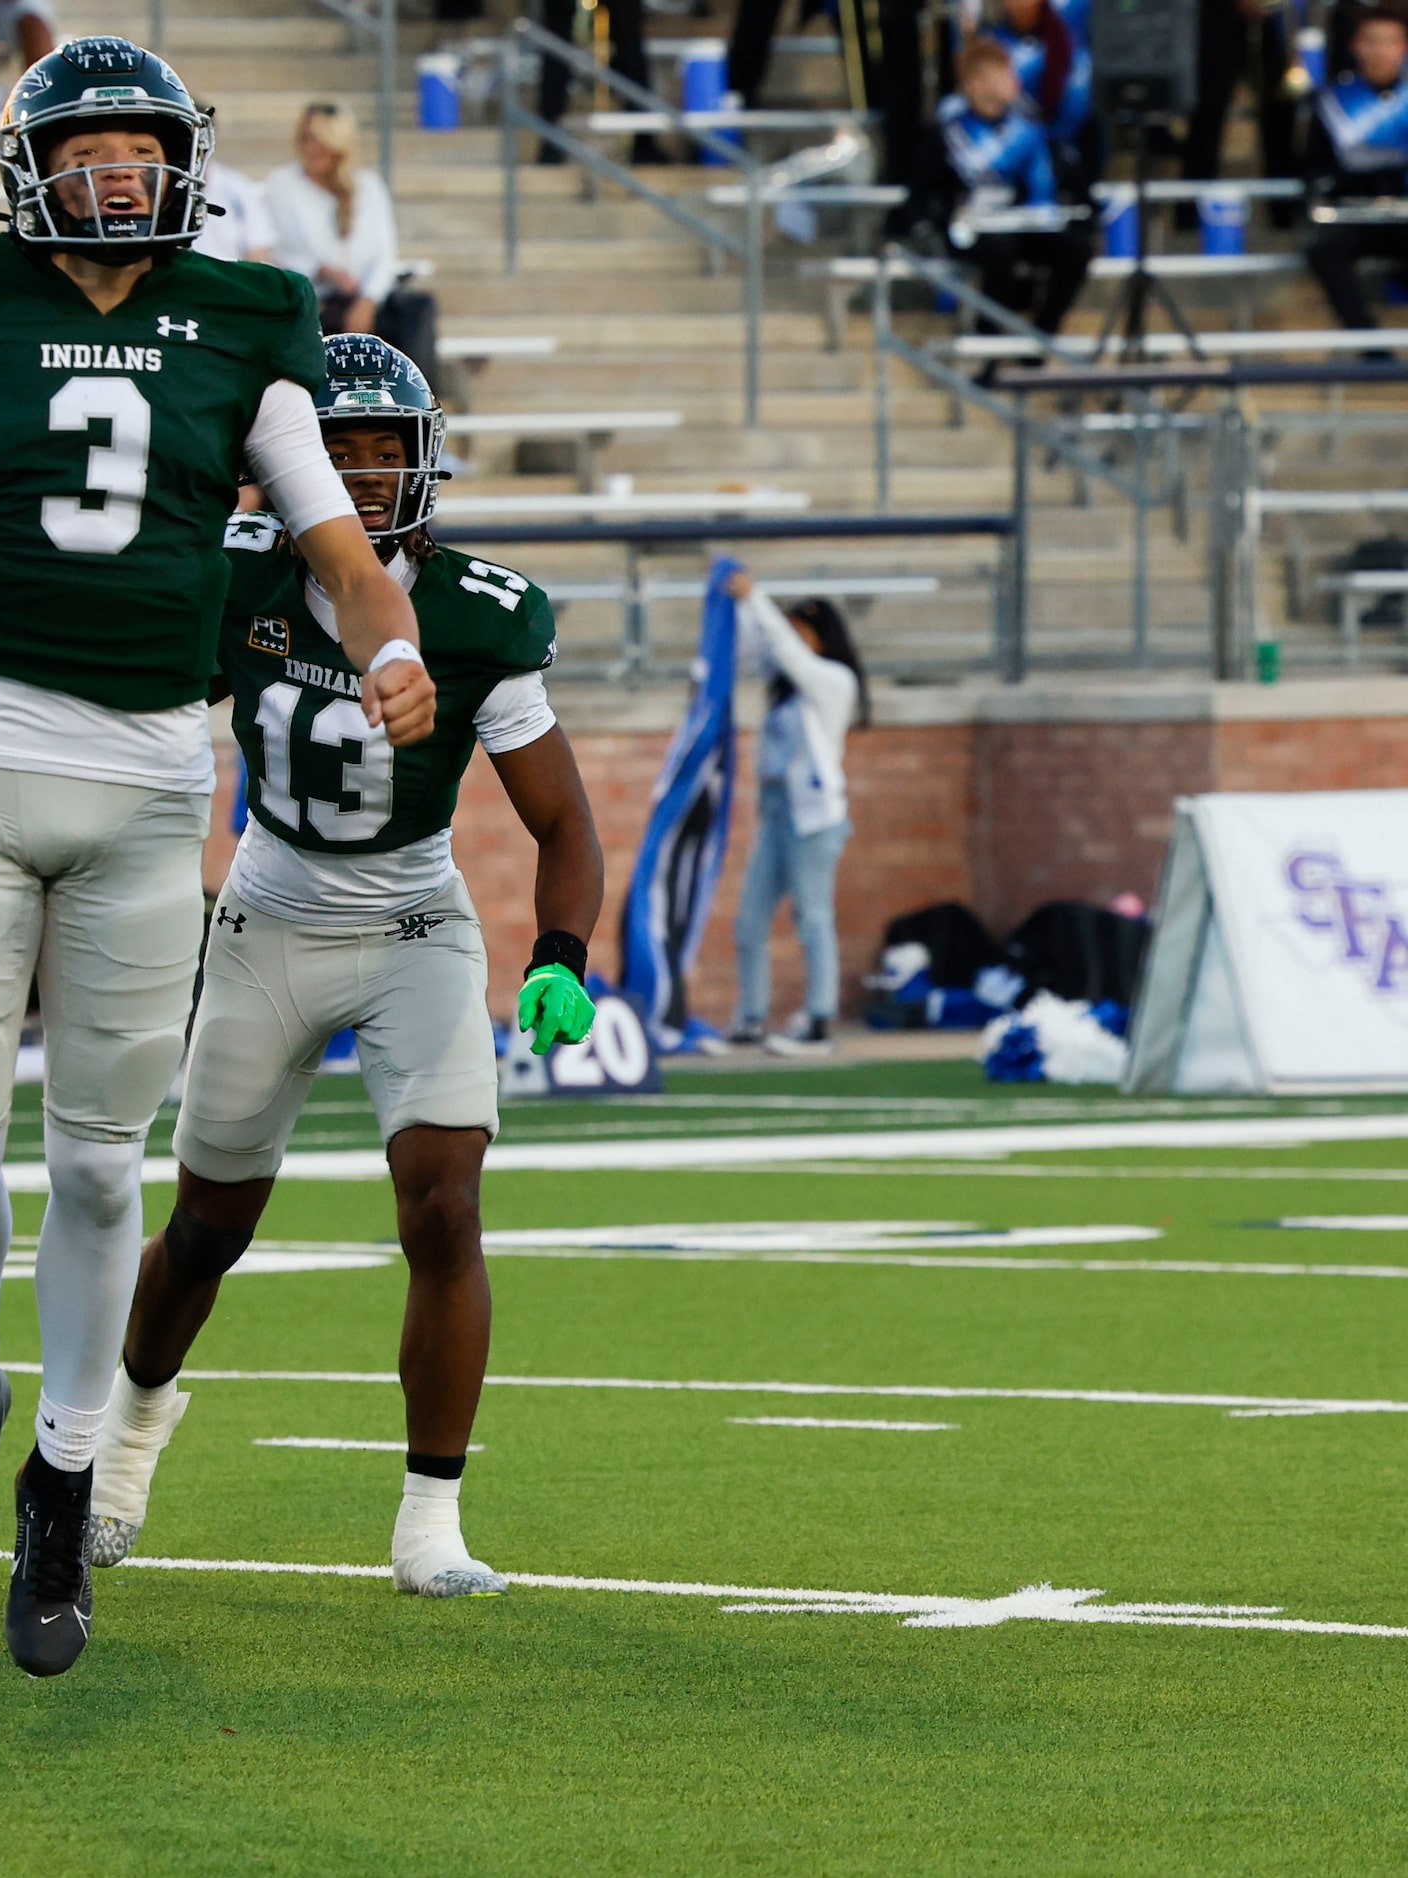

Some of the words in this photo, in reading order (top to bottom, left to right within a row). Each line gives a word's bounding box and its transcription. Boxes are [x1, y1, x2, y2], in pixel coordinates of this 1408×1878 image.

[40, 343, 163, 372] INDIANS
[40, 376, 152, 554] 3
[458, 559, 530, 612] 13
[253, 615, 287, 639] PC
[284, 658, 362, 698] INDIAN
[254, 680, 395, 842] 13
